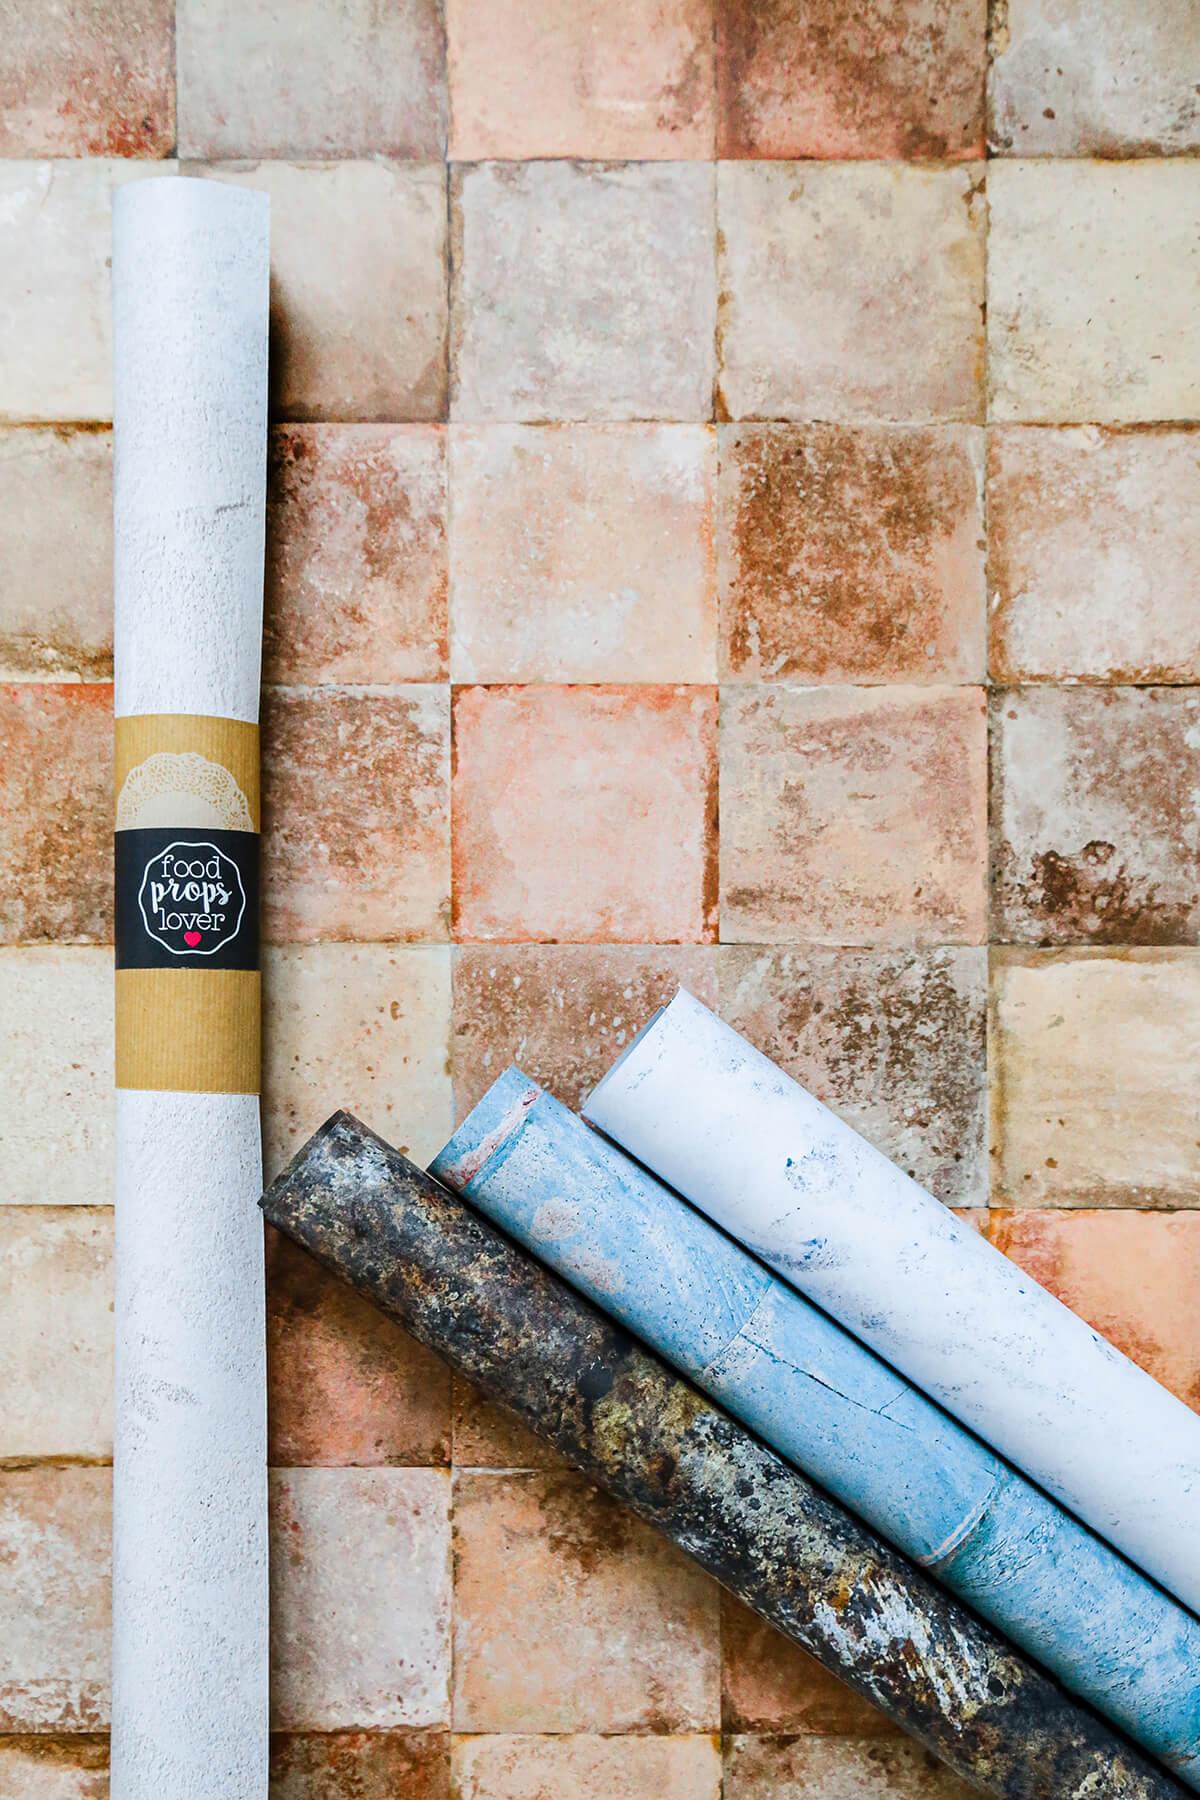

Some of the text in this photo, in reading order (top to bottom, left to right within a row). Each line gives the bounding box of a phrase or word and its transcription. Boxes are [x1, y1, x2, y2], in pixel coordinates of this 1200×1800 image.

[161, 855, 222, 879] food
[151, 878, 232, 913] props
[158, 907, 225, 931] lover
